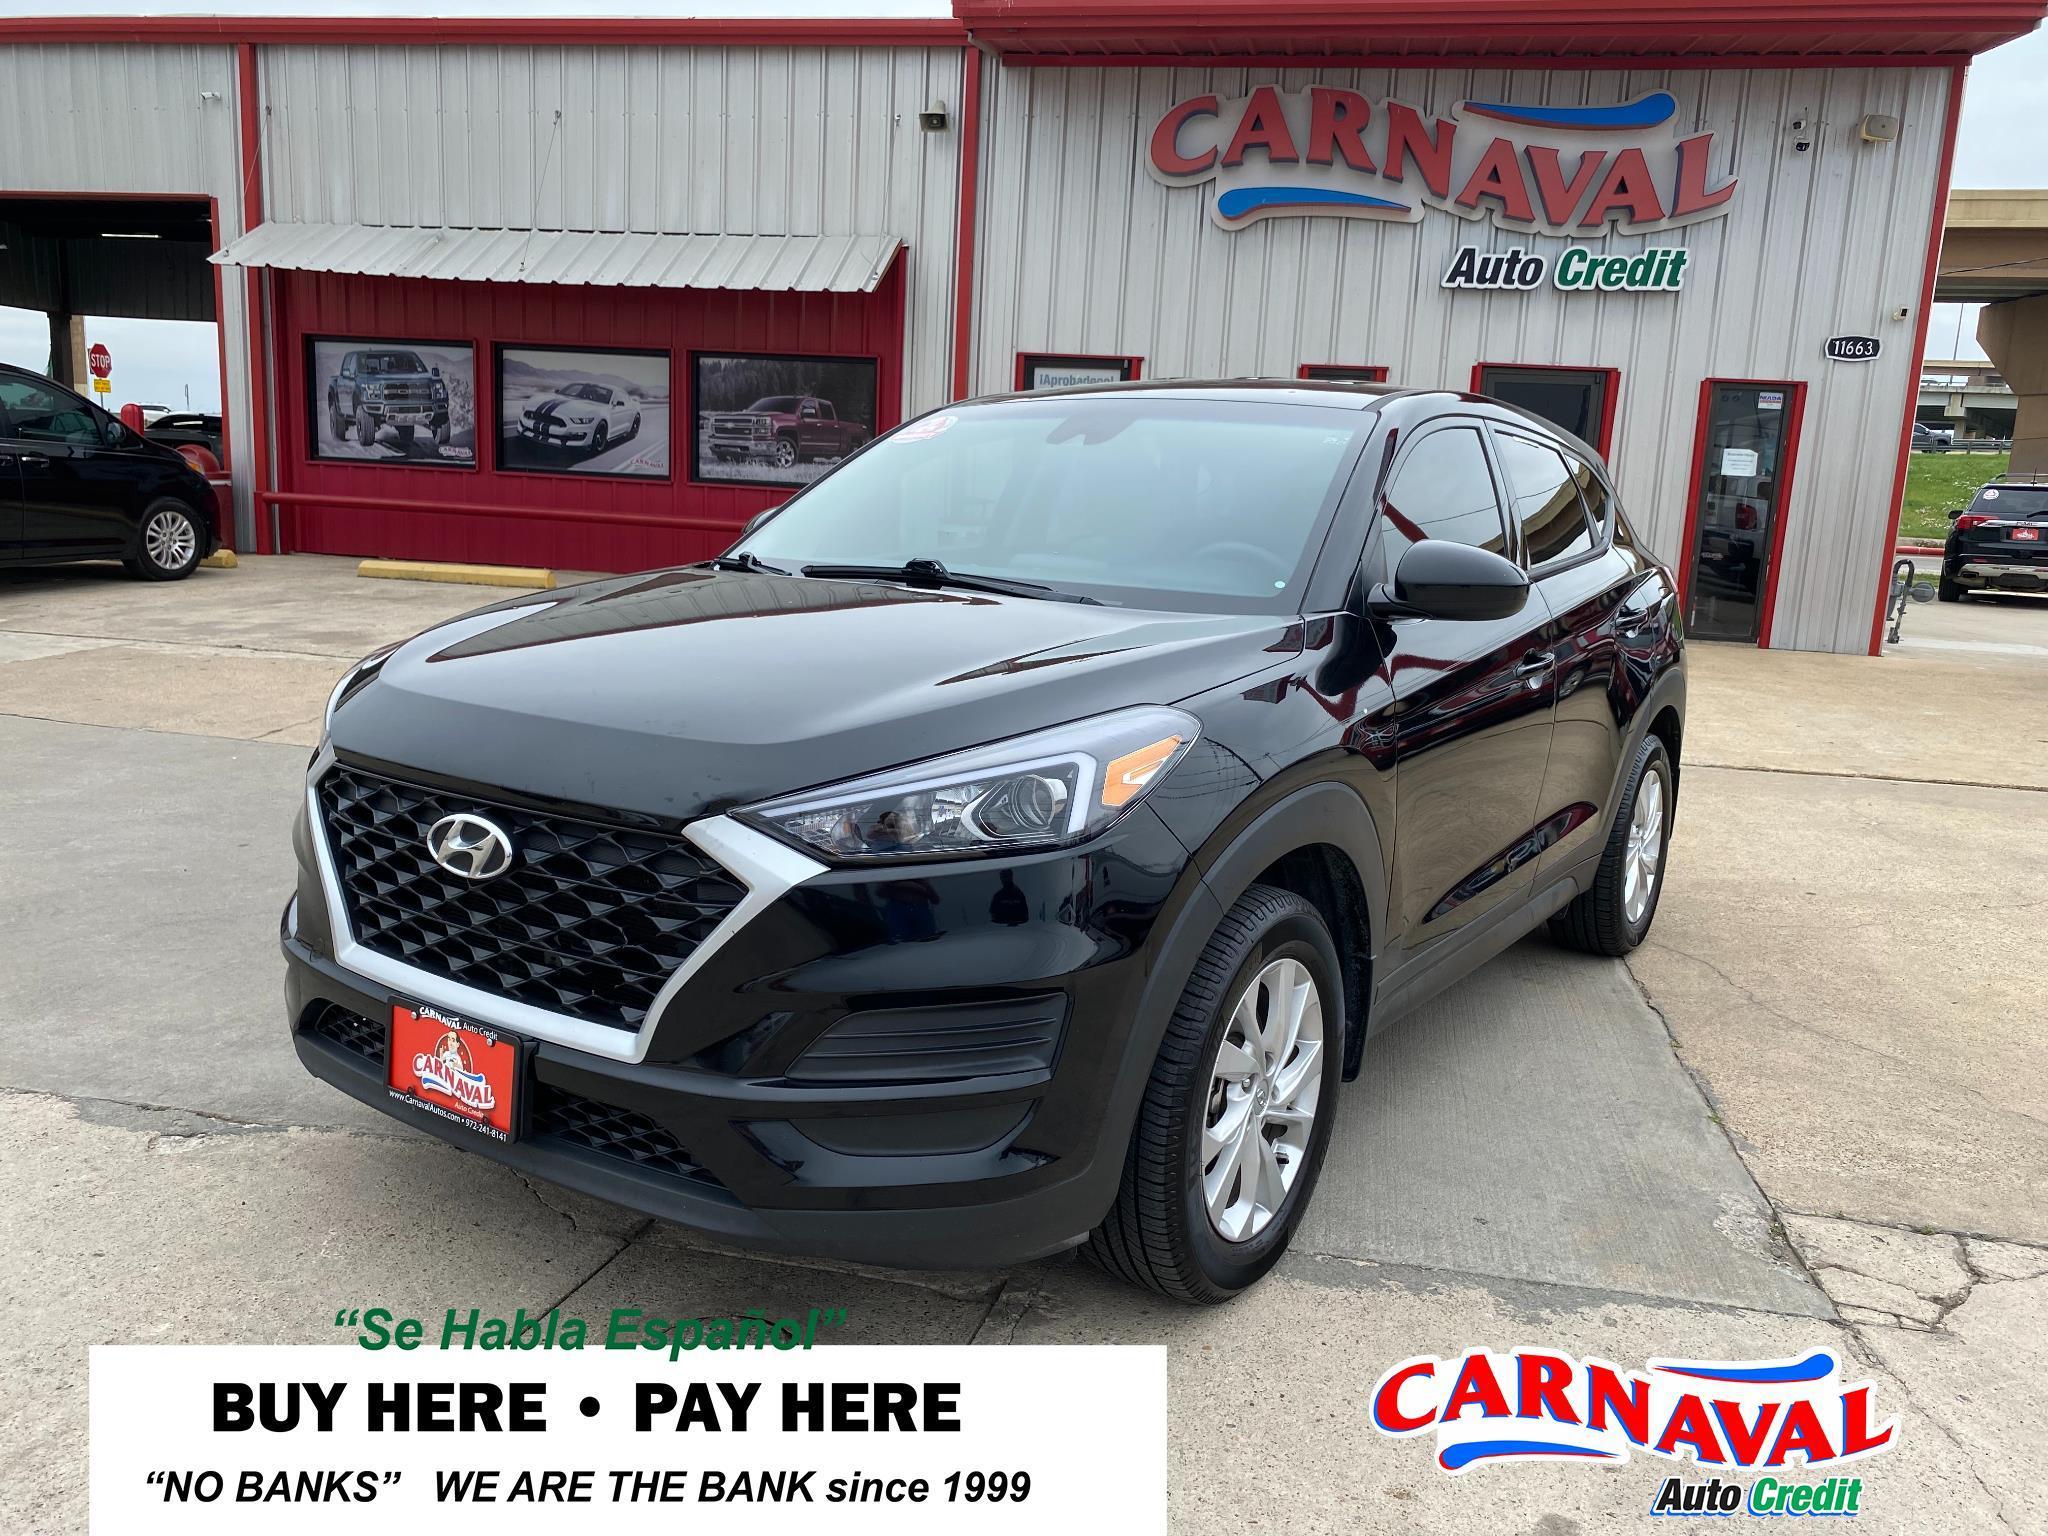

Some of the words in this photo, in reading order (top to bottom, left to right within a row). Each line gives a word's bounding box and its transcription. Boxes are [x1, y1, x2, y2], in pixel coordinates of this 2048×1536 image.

[1150, 86, 1738, 228] CARNAVAL
[1446, 248, 1544, 286] Auto
[1556, 248, 1687, 288] Credit
[91, 353, 110, 368] STOP
[1833, 340, 1874, 355] 11663
[420, 1006, 462, 1030] CARNAVAL
[462, 1021, 478, 1034] Auto
[478, 1027, 498, 1041] Credit
[412, 1052, 494, 1107] CARNAVAL
[388, 1089, 461, 1124] www.CarnavalAutos.com
[464, 1118, 507, 1143] 972-241-8141
[454, 1101, 468, 1112] Auto
